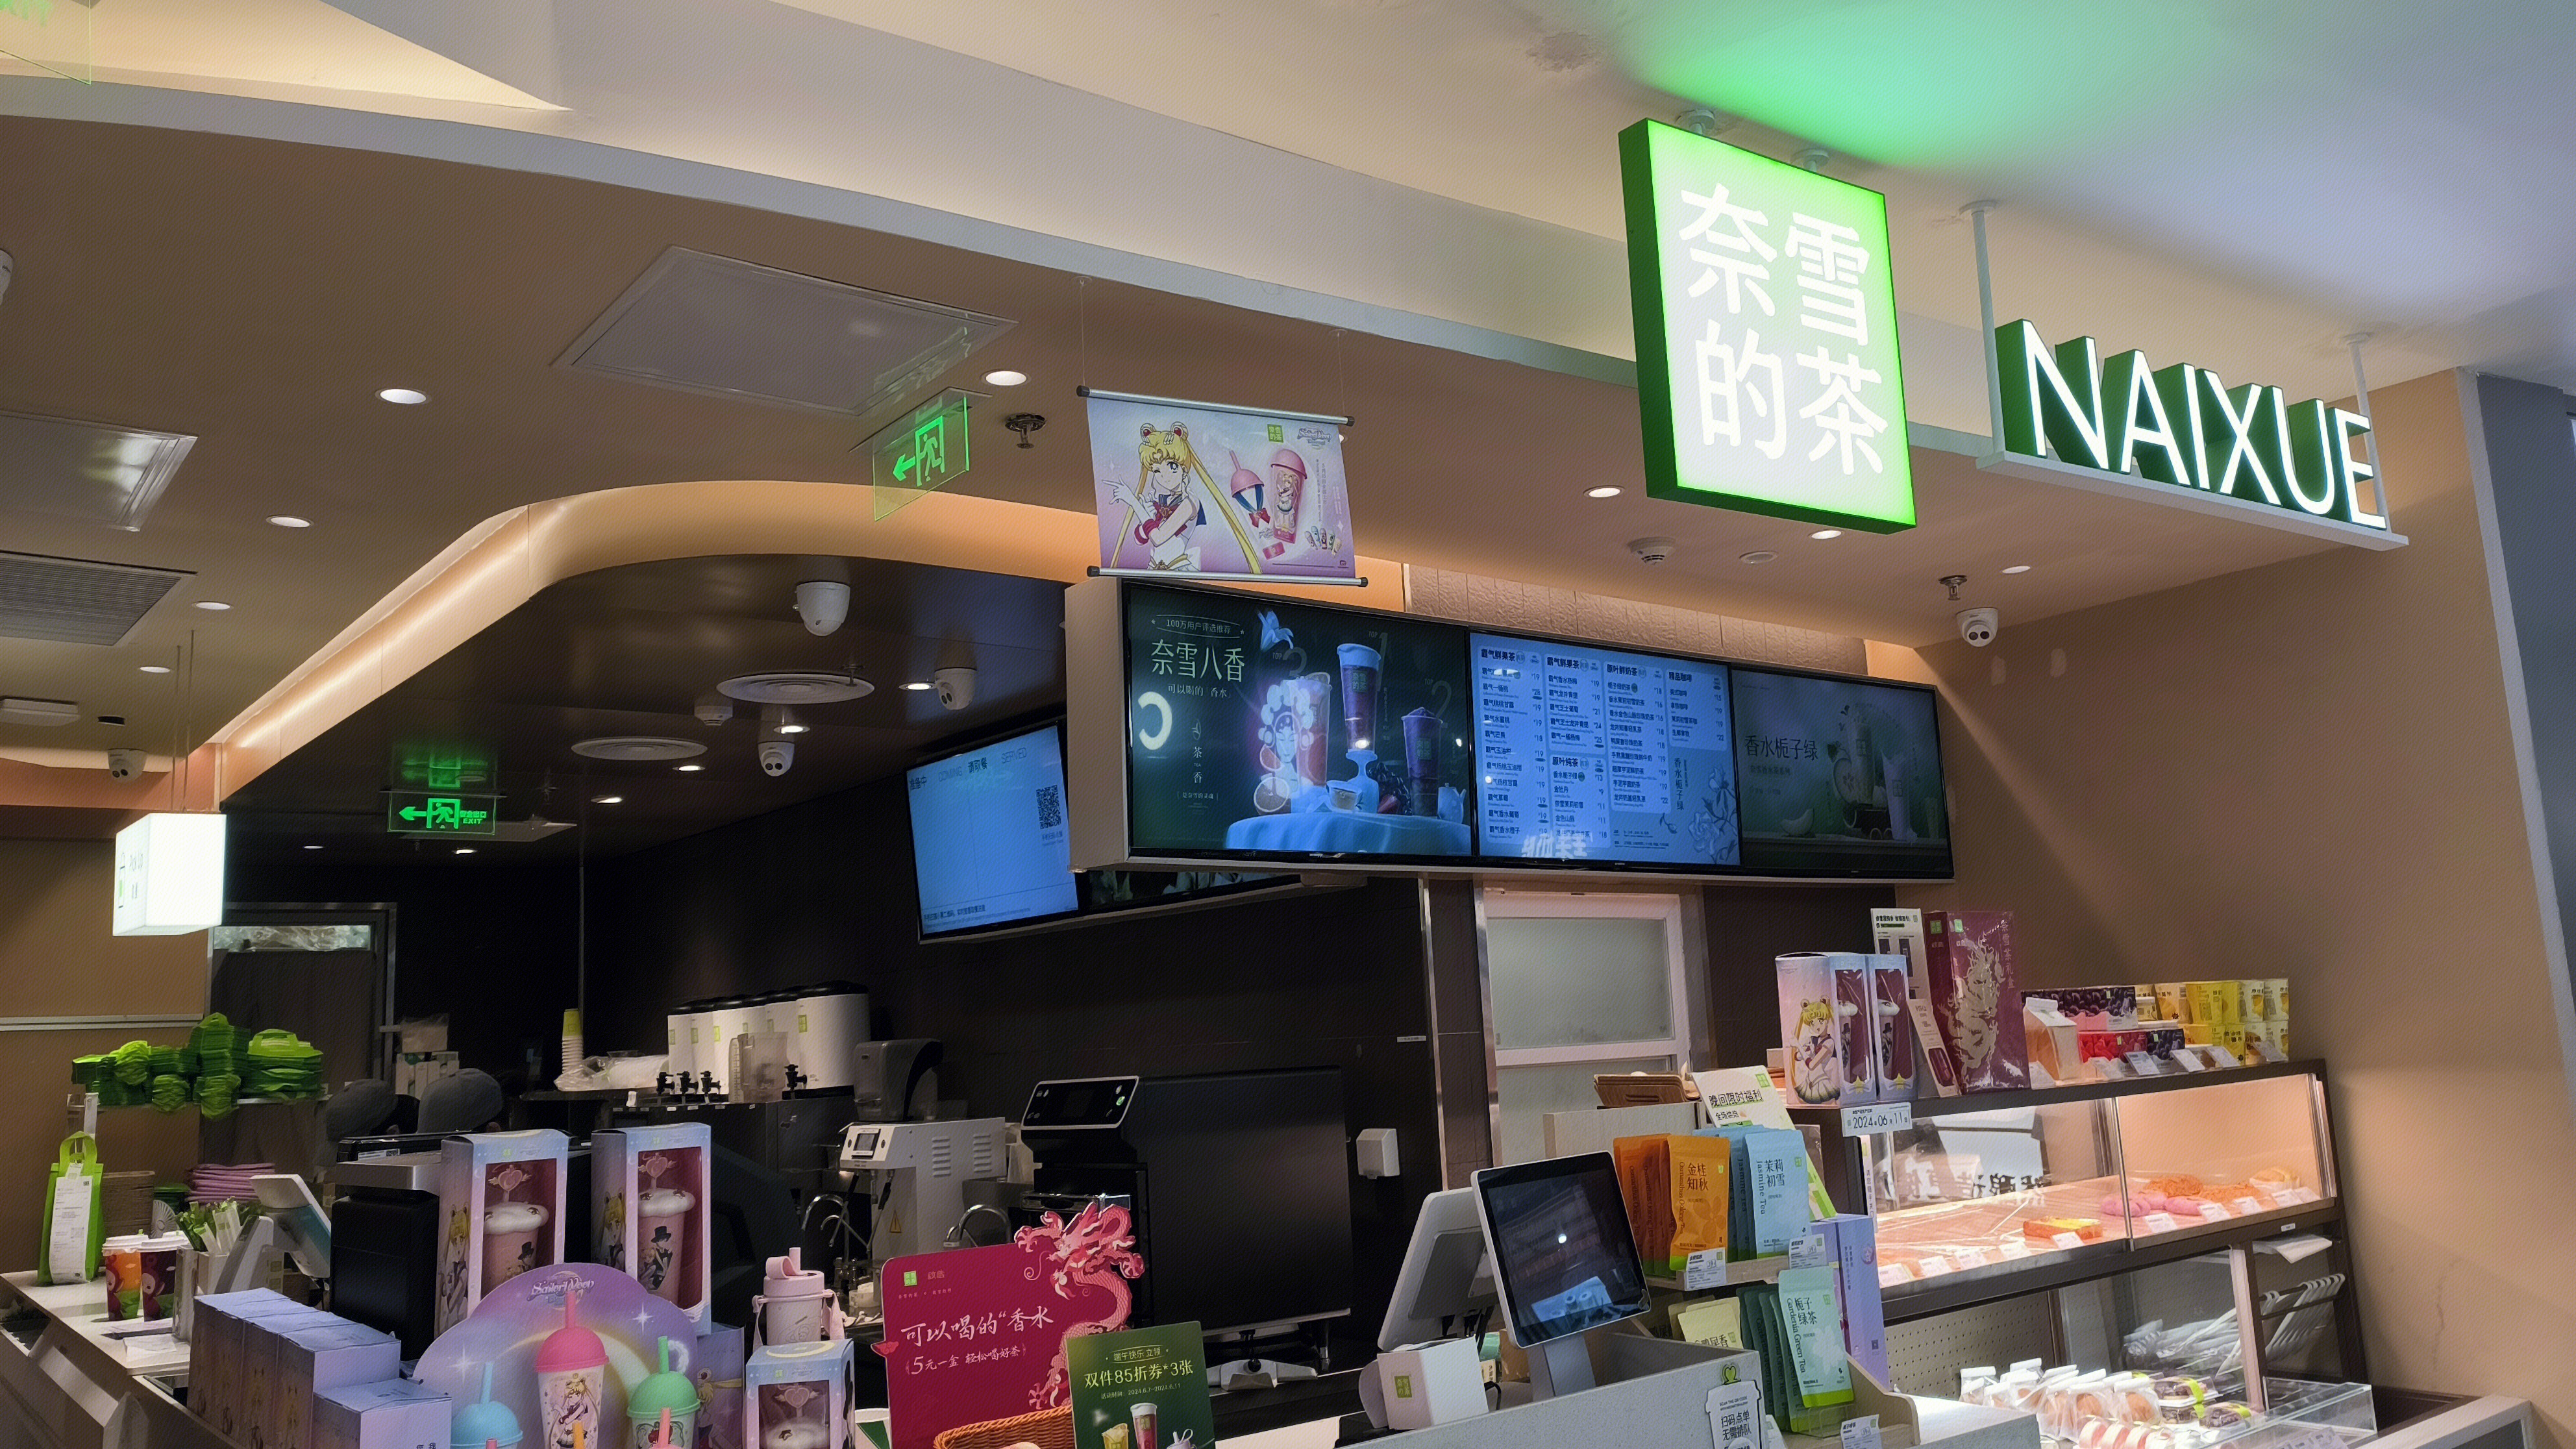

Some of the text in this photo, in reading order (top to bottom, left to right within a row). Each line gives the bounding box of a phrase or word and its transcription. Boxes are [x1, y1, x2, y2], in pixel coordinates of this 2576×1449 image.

[1679, 183, 1870, 345] 奈雪
[1694, 319, 1888, 475] 的茶
[2020, 320, 2387, 530] NAIXUE
[1151, 639, 1245, 683] 奈雪八香
[1193, 747, 1202, 758] 茶
[1744, 735, 1818, 761] 香水栀子绿
[1193, 772, 1202, 783] 香
[1674, 758, 1684, 811] 香水栀子绿
[1688, 1162, 1707, 1176] 金桂
[1765, 1159, 1783, 1172] 茉莉
[1687, 1176, 1709, 1191] 知秋
[1756, 1160, 1765, 1196] Jasmine
[1766, 1174, 1785, 1187] 初雪
[1794, 1297, 1812, 1311] 栀子
[1787, 1298, 1798, 1333] Gardenia
[1798, 1311, 1816, 1325] 绿茶
[965, 1344, 1021, 1364] 轻松喝好茶
[1113, 1347, 1161, 1361] 端午快乐 立领
[1721, 1409, 1750, 1428] 扫码点单
[1722, 1422, 1752, 1441] 无需排队
